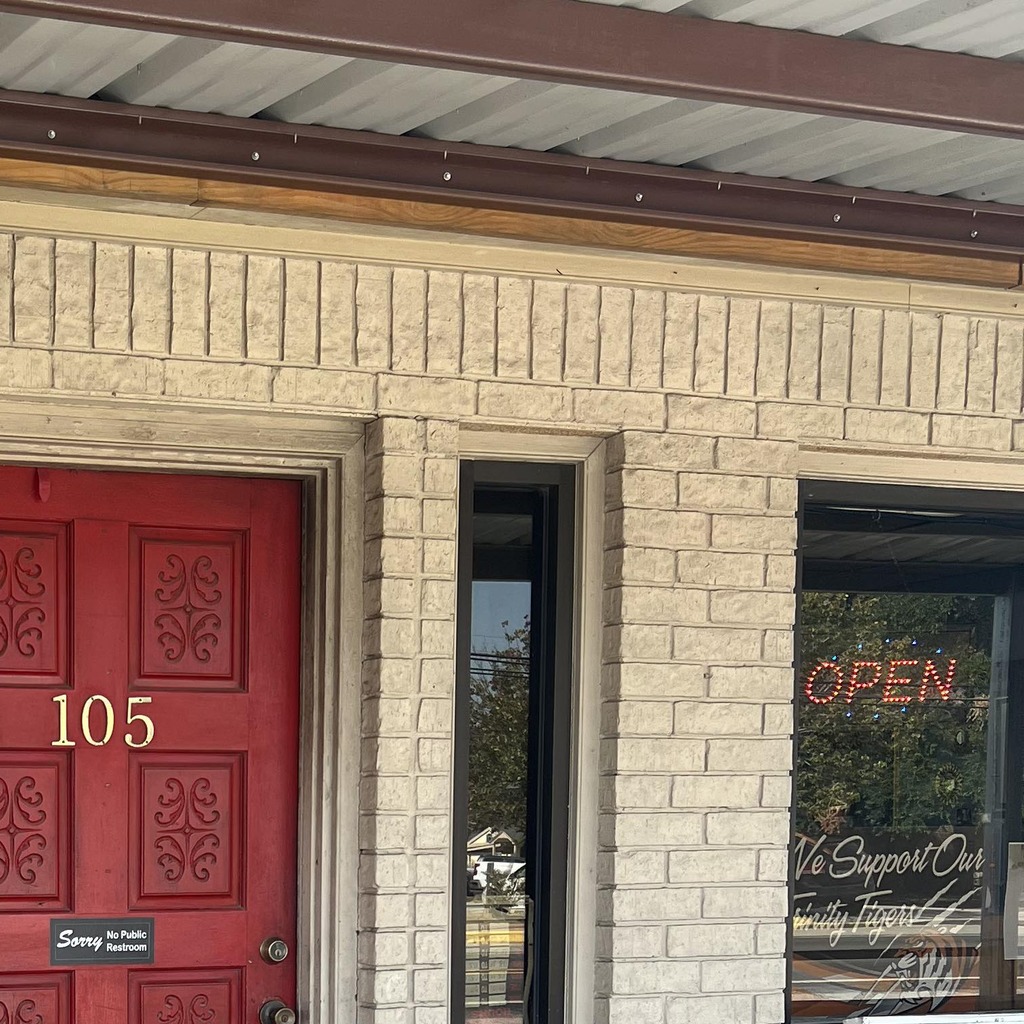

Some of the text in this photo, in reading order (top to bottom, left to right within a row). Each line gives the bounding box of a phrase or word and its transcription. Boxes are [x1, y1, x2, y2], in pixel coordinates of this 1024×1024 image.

[804, 658, 958, 705] OPEN
[51, 694, 155, 748] 105
[828, 835, 938, 889] Support
[932, 833, 986, 878] Our
[56, 929, 104, 952] Sorry
[106, 929, 147, 940] No Public
[851, 890, 921, 947] Tigers
[106, 942, 147, 952] Restroom
